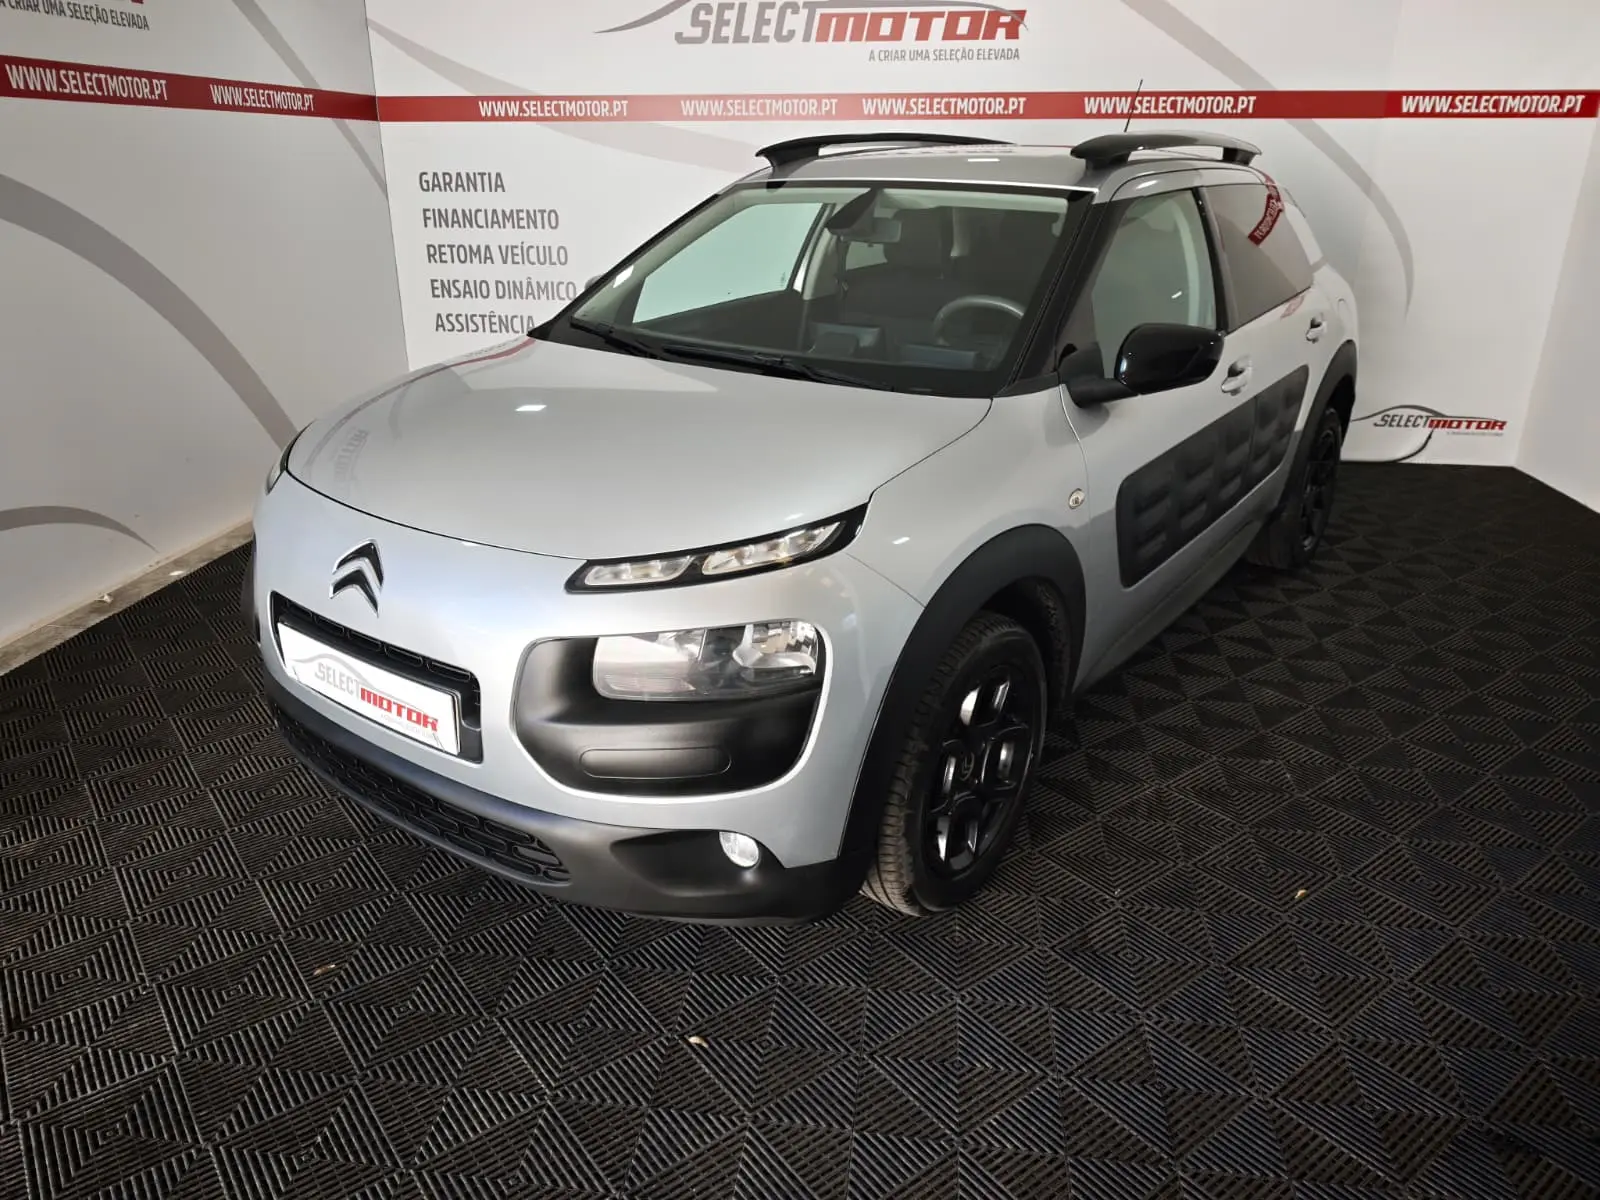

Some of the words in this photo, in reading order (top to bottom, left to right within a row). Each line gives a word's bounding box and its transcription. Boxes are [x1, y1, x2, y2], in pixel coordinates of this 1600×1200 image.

[42, 0, 67, 17] UMA
[66, 2, 109, 25] SELEÇÃO
[109, 9, 150, 31] ELEVADA
[868, 49, 877, 62] A
[878, 49, 907, 62] CRIAR
[908, 49, 931, 62] UMA
[933, 47, 975, 63] SELEÇÃO
[976, 47, 1020, 61] ELEVADA
[5, 63, 168, 101] WWW.SELECTMOTOR.PT
[209, 83, 314, 112] WWW.SELECTMOTOR.PT
[478, 99, 628, 118] WWW.SELECTMOTOR.PT
[680, 98, 838, 117] WWW.SELECTMOTOR.PT
[862, 96, 1026, 116] WWW.SELECTMOTOR.PT
[1083, 95, 1257, 115] WWW.SELECTMOTOR.PT
[1401, 94, 1585, 114] WWW.SELECTMOTOR.PT
[419, 171, 506, 193] GARANTIA
[422, 207, 559, 230] FINANCIAMENTO
[426, 243, 495, 265] RETOMA
[498, 241, 568, 266] VEÍCULO
[430, 278, 490, 299] ENSAIO
[495, 276, 577, 302] DINÂMICO
[435, 310, 536, 335] ASSISTÊNCIA
[1373, 413, 1507, 431] SELECTMOTOR
[314, 661, 439, 733] SELECTMOTOR
